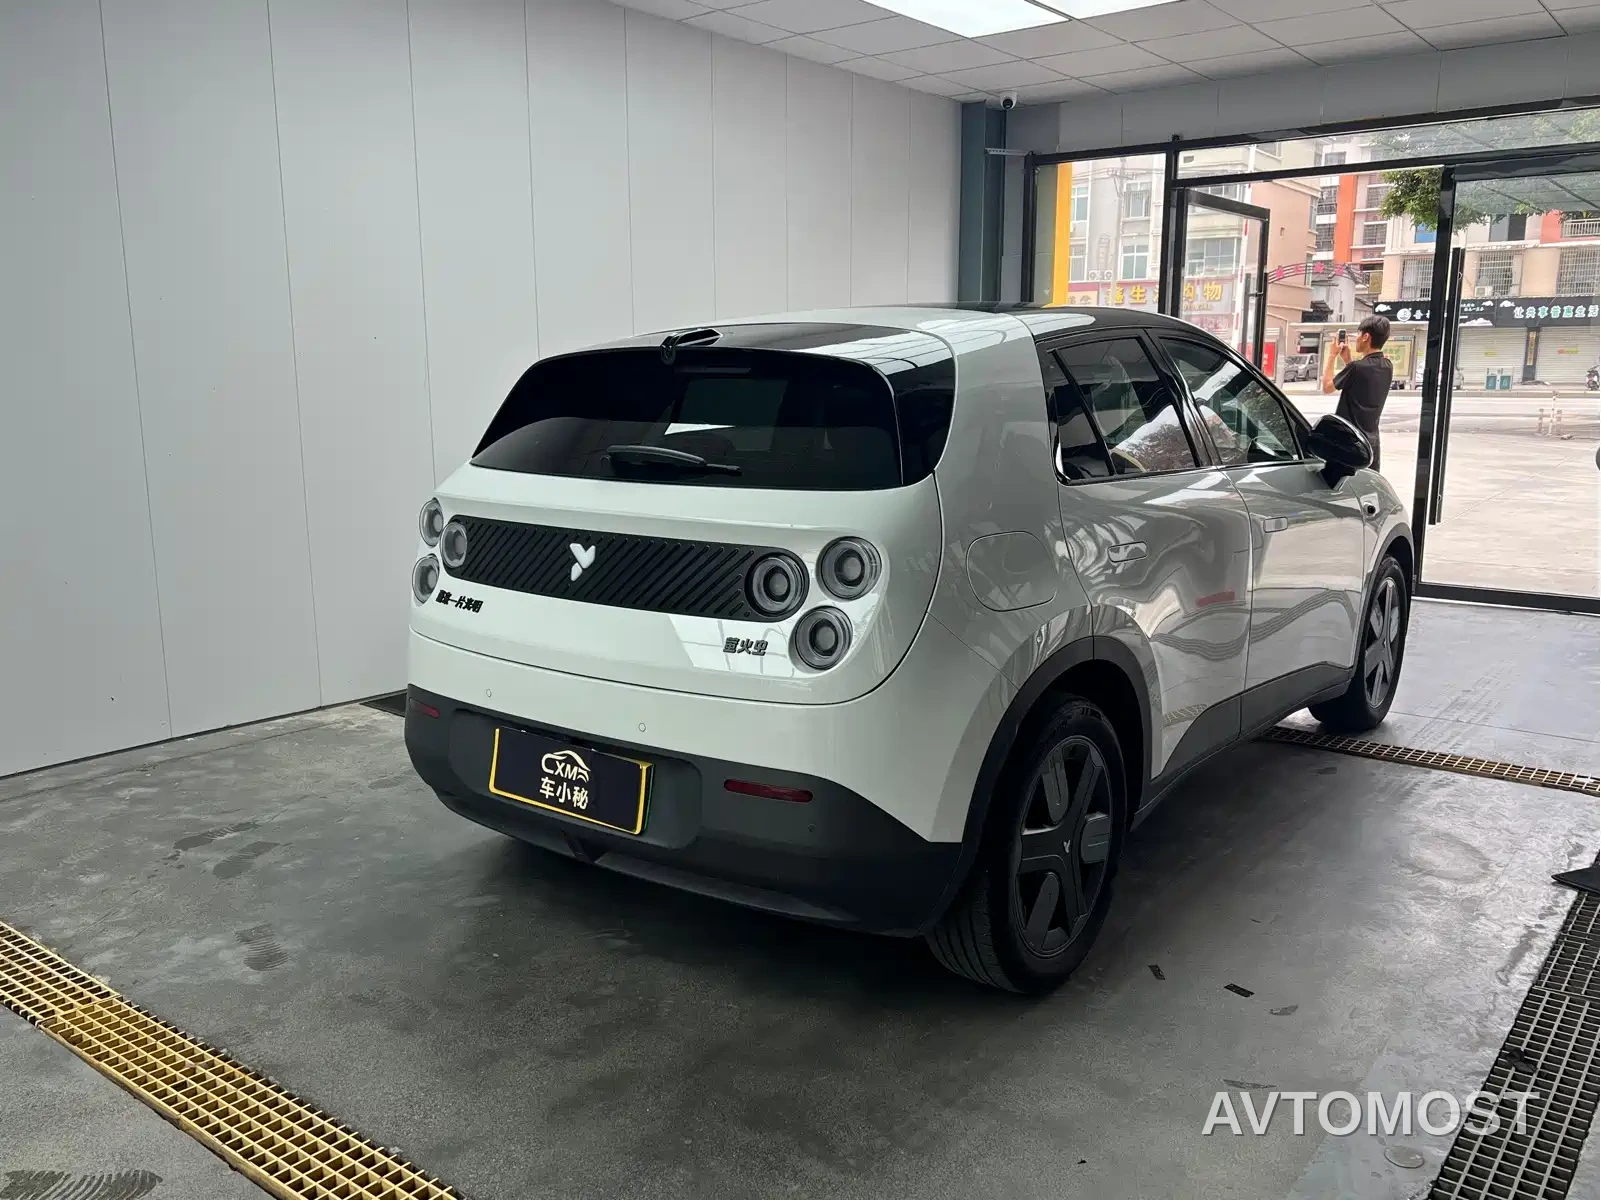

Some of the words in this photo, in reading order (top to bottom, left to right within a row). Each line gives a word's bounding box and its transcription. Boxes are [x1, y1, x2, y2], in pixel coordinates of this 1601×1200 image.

[723, 637, 769, 656] 萤火虫
[540, 777, 589, 810] 车小秘
